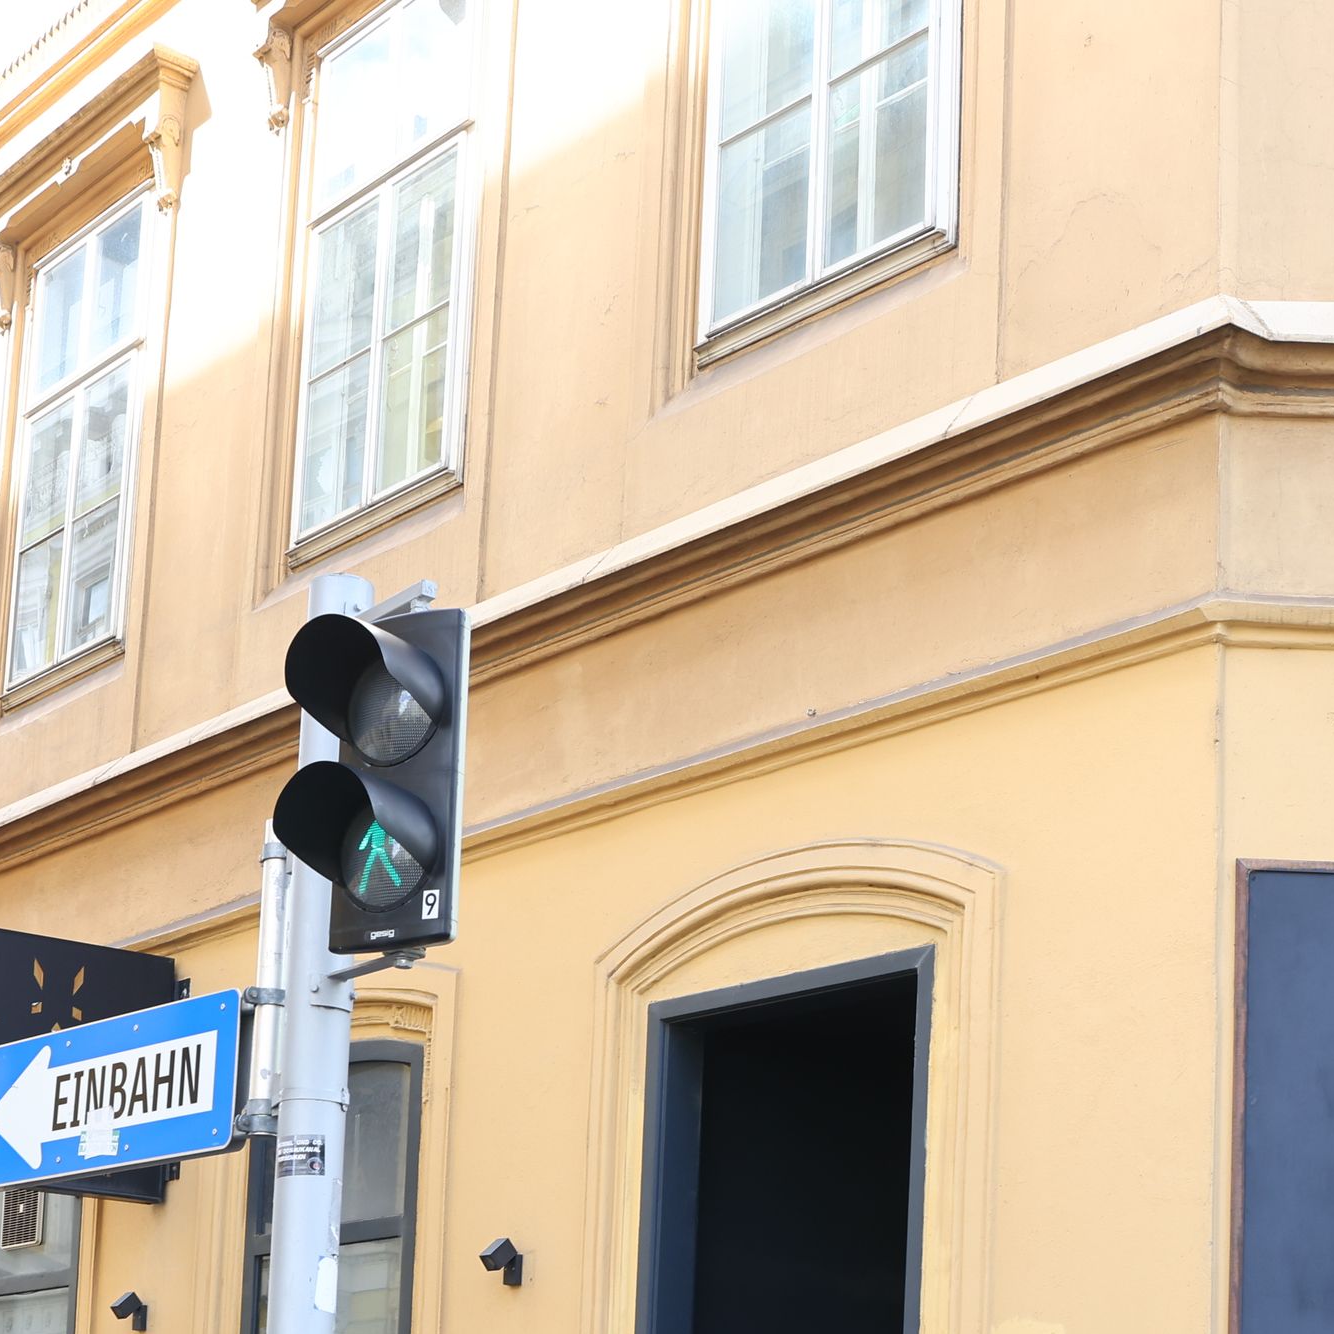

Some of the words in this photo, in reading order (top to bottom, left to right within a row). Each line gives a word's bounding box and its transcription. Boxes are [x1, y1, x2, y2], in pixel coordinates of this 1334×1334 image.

[425, 893, 437, 915] 9
[370, 929, 395, 940] gesig
[52, 1044, 201, 1131] EINBAHN
